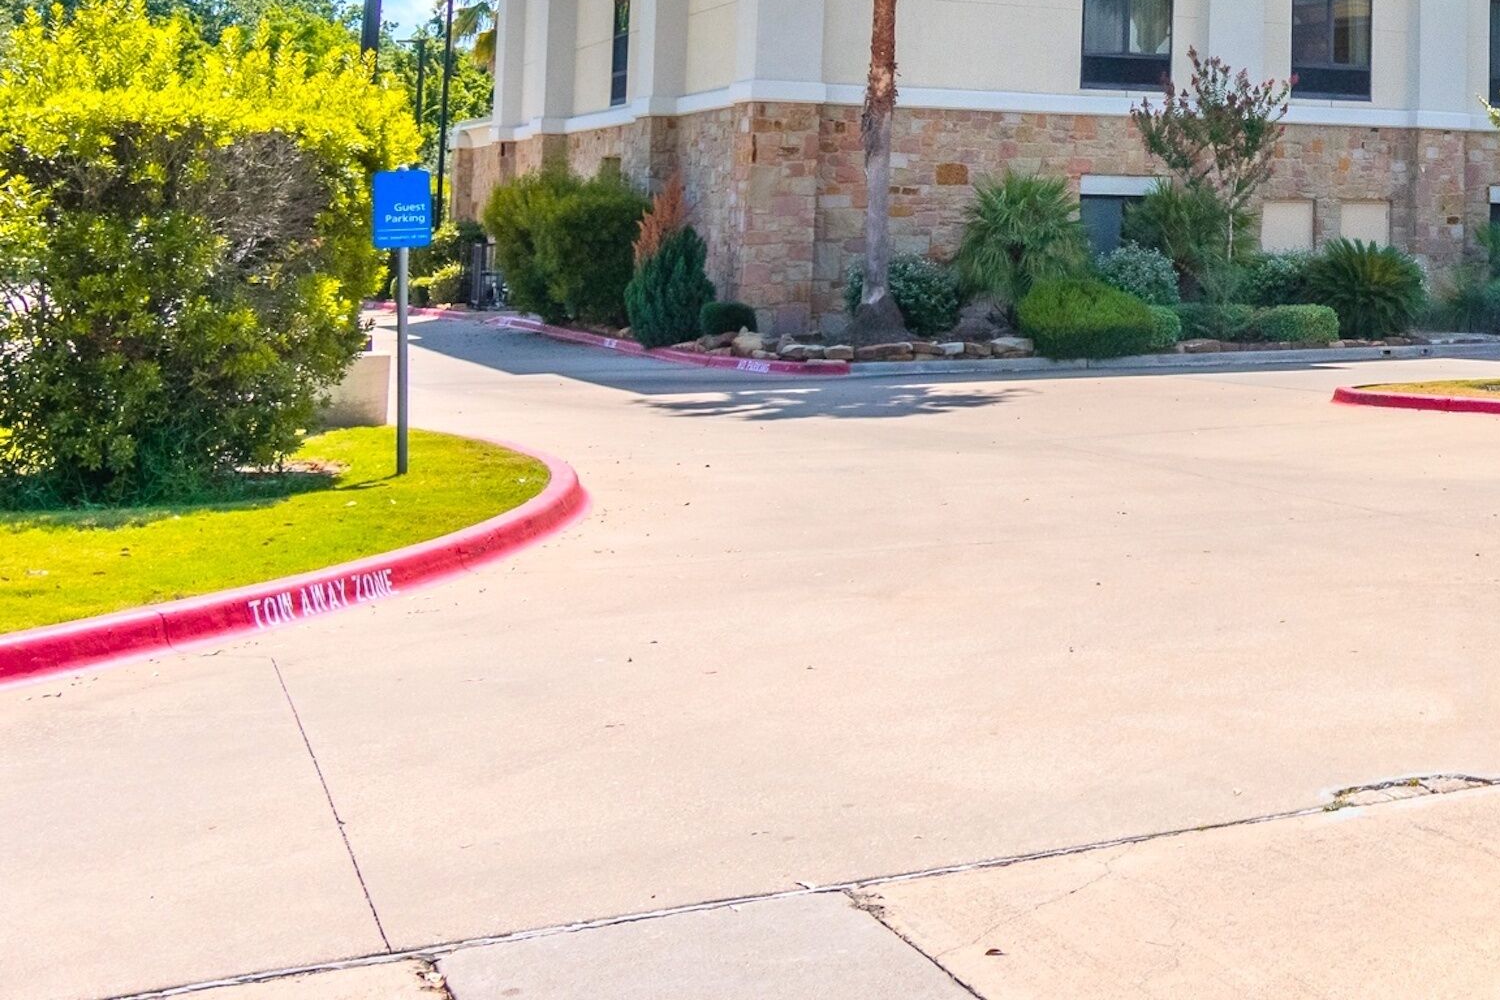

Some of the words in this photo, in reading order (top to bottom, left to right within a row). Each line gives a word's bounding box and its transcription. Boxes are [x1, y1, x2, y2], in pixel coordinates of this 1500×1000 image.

[394, 203, 425, 211] Guest
[385, 214, 425, 224] Parking
[248, 592, 296, 630] TOW
[300, 577, 349, 617] AWAY
[351, 568, 400, 602] ZONE
